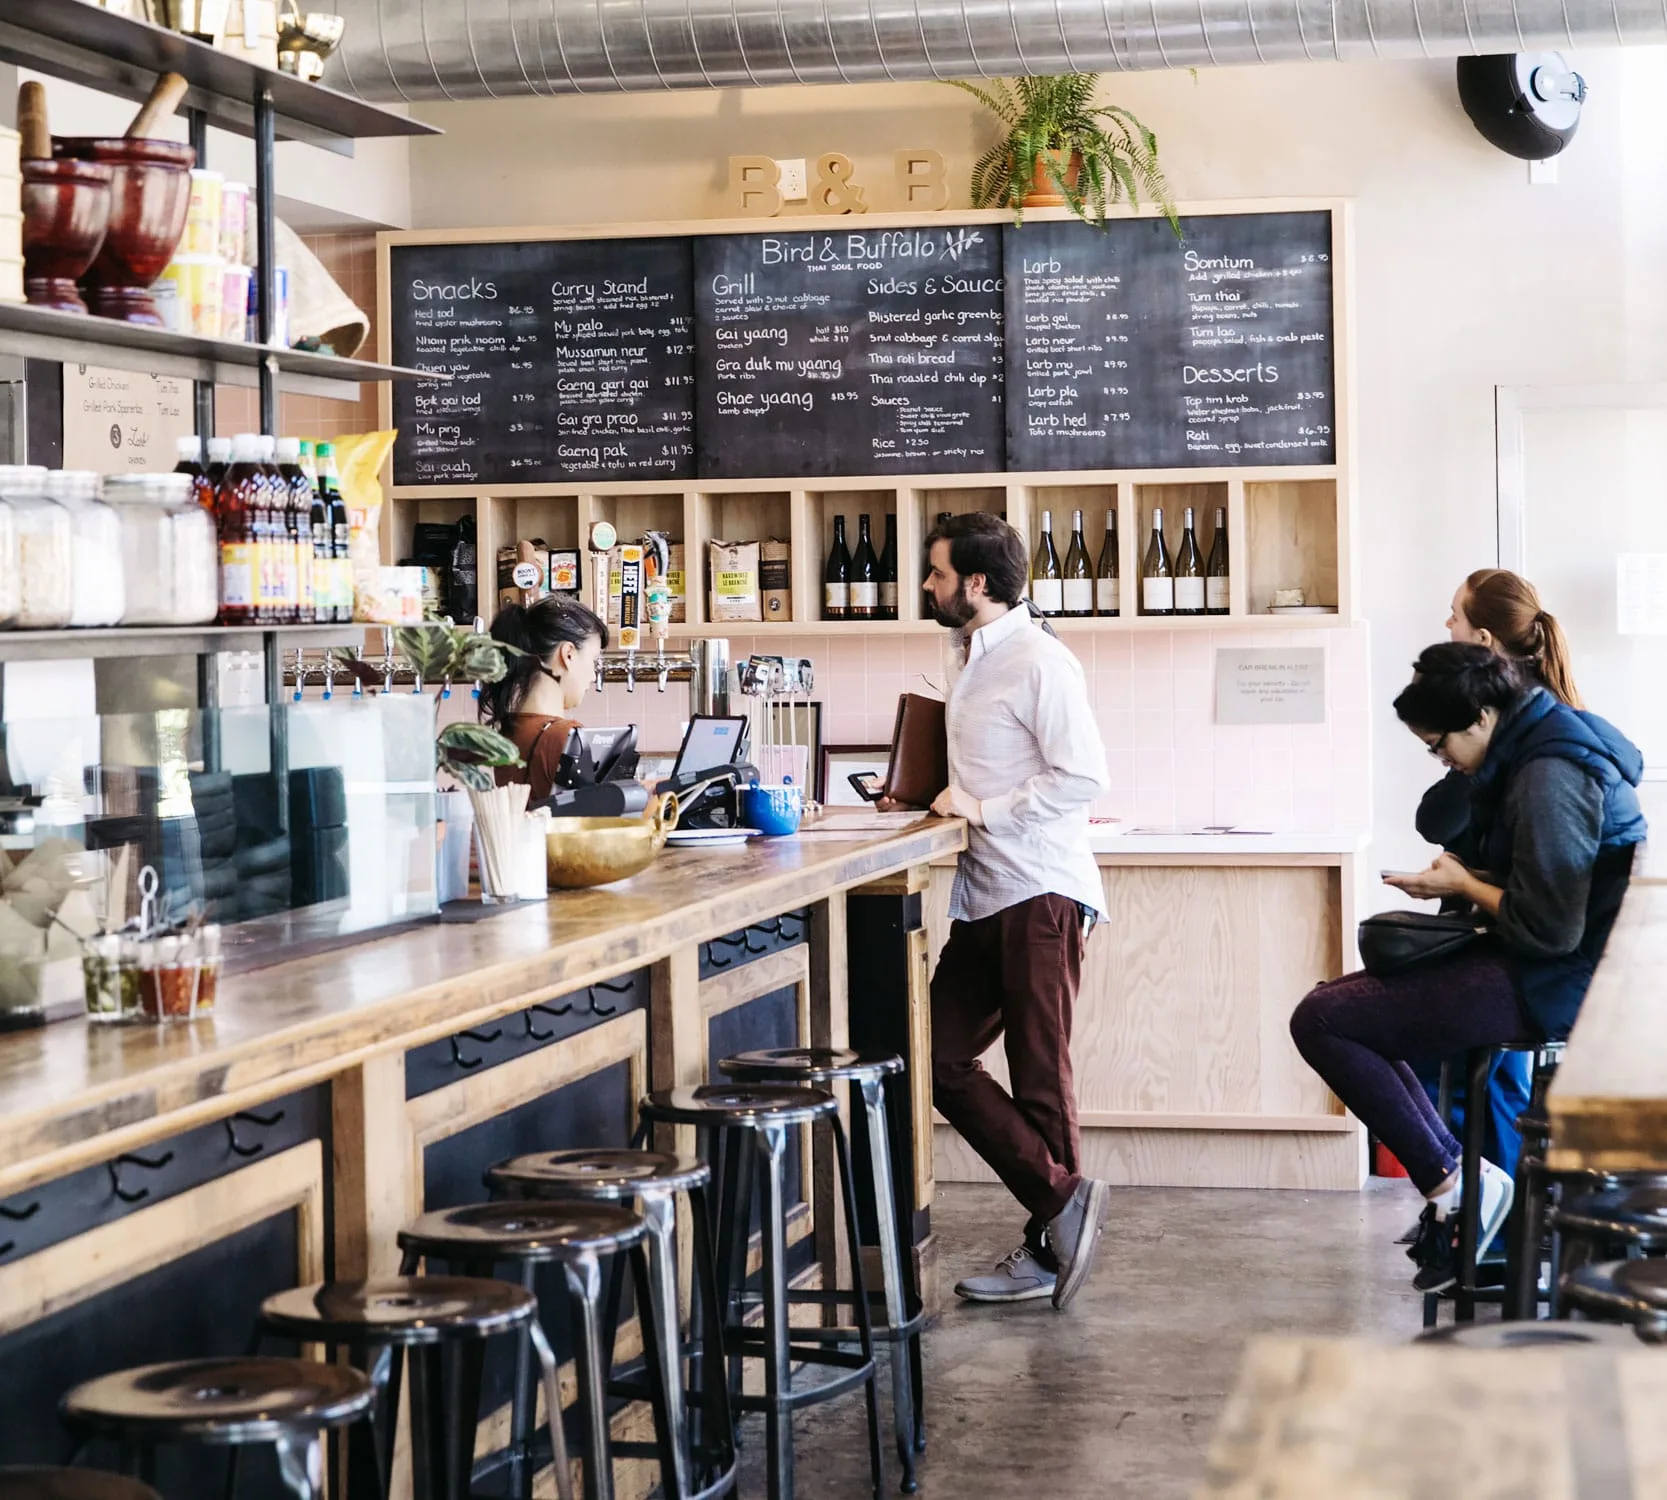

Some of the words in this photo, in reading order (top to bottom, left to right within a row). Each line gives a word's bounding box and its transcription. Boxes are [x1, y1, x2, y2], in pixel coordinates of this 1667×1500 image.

[728, 154, 784, 218] B
[809, 152, 868, 215] &
[895, 149, 950, 211] B
[762, 236, 814, 264] Bird
[819, 237, 839, 261] &
[848, 232, 934, 259] Buffalo
[857, 262, 883, 270] FOOD
[1024, 256, 1061, 273] Larb
[1184, 251, 1254, 271] Somtum
[413, 277, 497, 300] Snacks
[552, 282, 594, 300] Curry
[603, 276, 647, 294] Stand
[712, 272, 754, 295] Grill
[868, 277, 917, 295] Sides
[925, 278, 936, 294] &
[793, 293, 830, 305] cabbage
[1216, 290, 1240, 301] thai
[415, 309, 433, 318] Hed
[438, 306, 453, 317] tod
[868, 309, 919, 323] Blistered
[925, 310, 954, 325] garlic
[1025, 314, 1049, 323] Larb
[1052, 313, 1068, 326] gai
[554, 320, 571, 332] Mu
[578, 318, 603, 336] palo
[1217, 326, 1235, 336] lao
[716, 328, 738, 340] Gai
[744, 328, 788, 346] yaang
[895, 332, 937, 348] cabbage
[1026, 337, 1049, 346] Larb
[622, 347, 646, 357] neur
[868, 353, 893, 363] Thai
[897, 354, 914, 363] roti
[918, 350, 955, 364] bread
[716, 359, 740, 371] Gra
[746, 356, 772, 371] duk
[776, 361, 794, 371] mu
[798, 359, 841, 378] yaang
[1027, 360, 1052, 369] Larb
[869, 374, 893, 383] Thai
[897, 370, 938, 383] roasted
[970, 372, 987, 388] dip
[1183, 362, 1279, 384] Desserts
[557, 378, 595, 394] Gaeng
[601, 378, 624, 394] gari
[630, 376, 648, 393] gai
[1028, 386, 1055, 397] Larb
[1060, 386, 1078, 400] pla
[462, 392, 480, 404] tod
[717, 392, 754, 405] Ghae
[761, 392, 813, 412] yaang
[872, 396, 910, 407] Sauces
[558, 413, 578, 425] Gai
[582, 415, 602, 429] gra
[607, 414, 638, 428] prao
[1029, 414, 1059, 425] Larb
[1064, 412, 1086, 426] hed
[416, 423, 434, 434] Mu
[439, 426, 460, 438] ping
[1056, 429, 1106, 438] mushrooms
[1186, 430, 1209, 440] Roti
[872, 438, 895, 448] Rice
[558, 444, 598, 462] Gaeng
[604, 442, 628, 459] pak
[661, 444, 693, 455] $11.95
[655, 459, 676, 471] curry
[623, 566, 638, 594] HEFE
